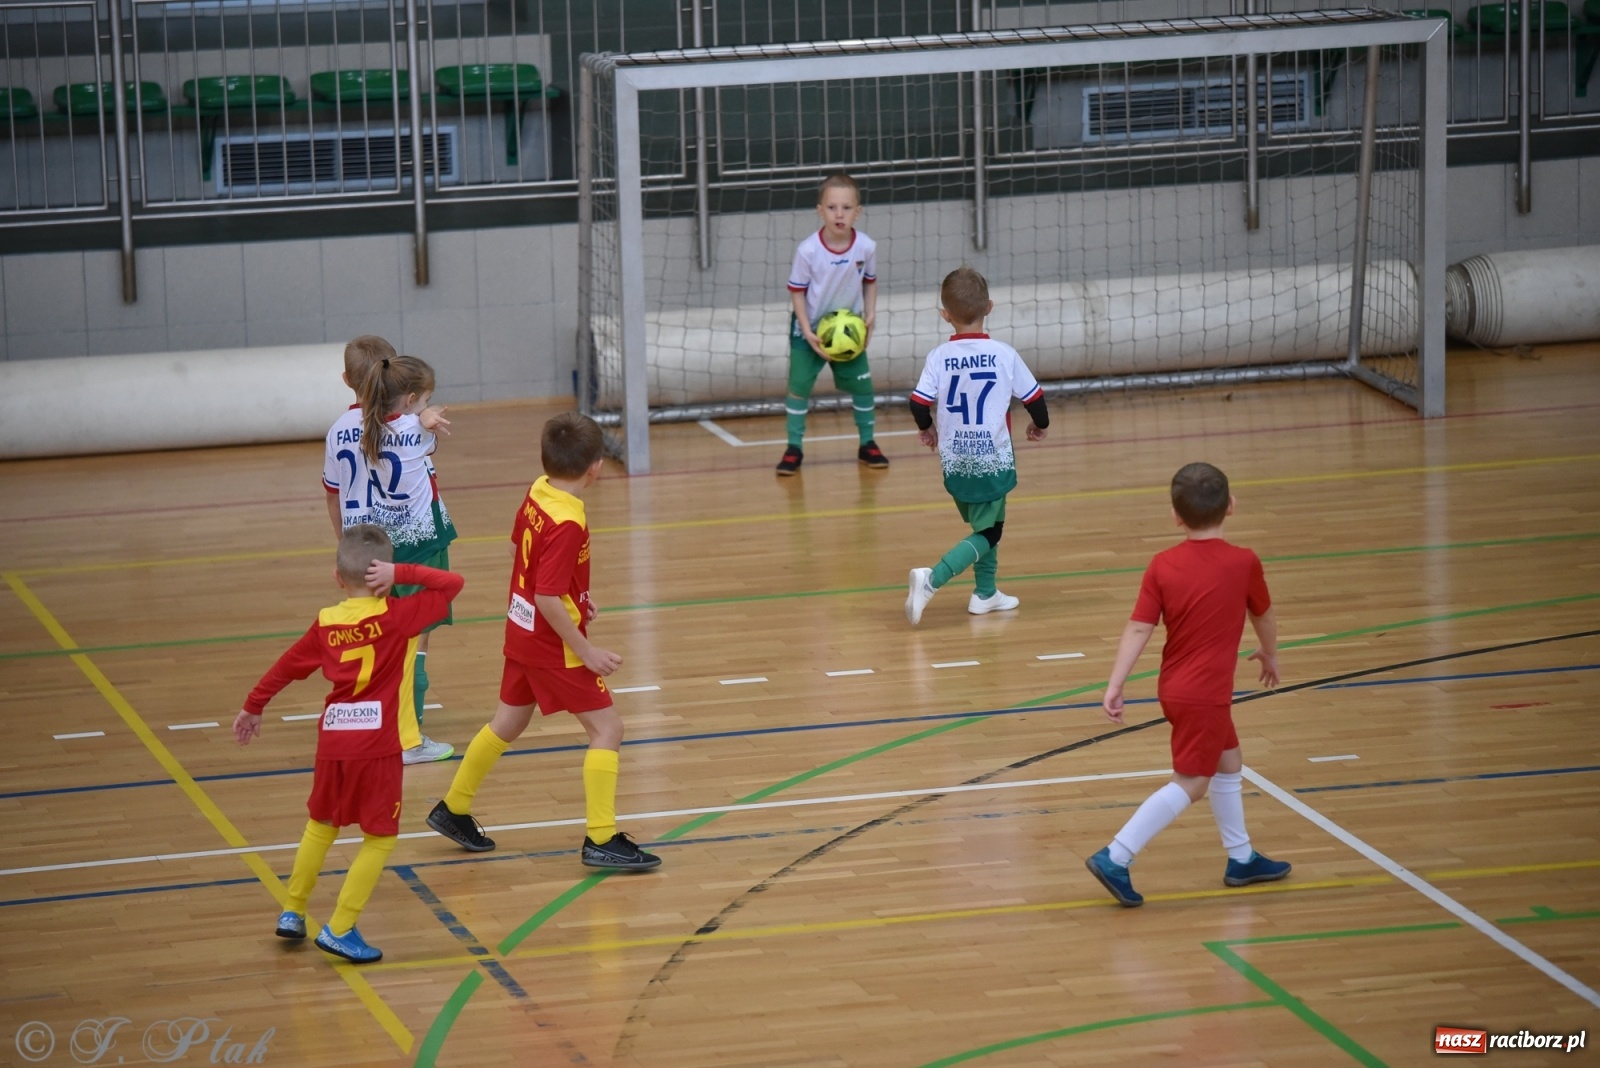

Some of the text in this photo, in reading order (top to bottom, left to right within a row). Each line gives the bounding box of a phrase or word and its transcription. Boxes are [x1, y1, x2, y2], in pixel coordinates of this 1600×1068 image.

[944, 354, 997, 372] FRANEK
[946, 372, 998, 425] 47
[337, 427, 363, 446] FAB
[328, 621, 383, 647] GMKS 21
[339, 643, 376, 697] 7
[596, 676, 605, 693] 9
[336, 707, 378, 718] PIVEXIN
[391, 801, 401, 819] 7
